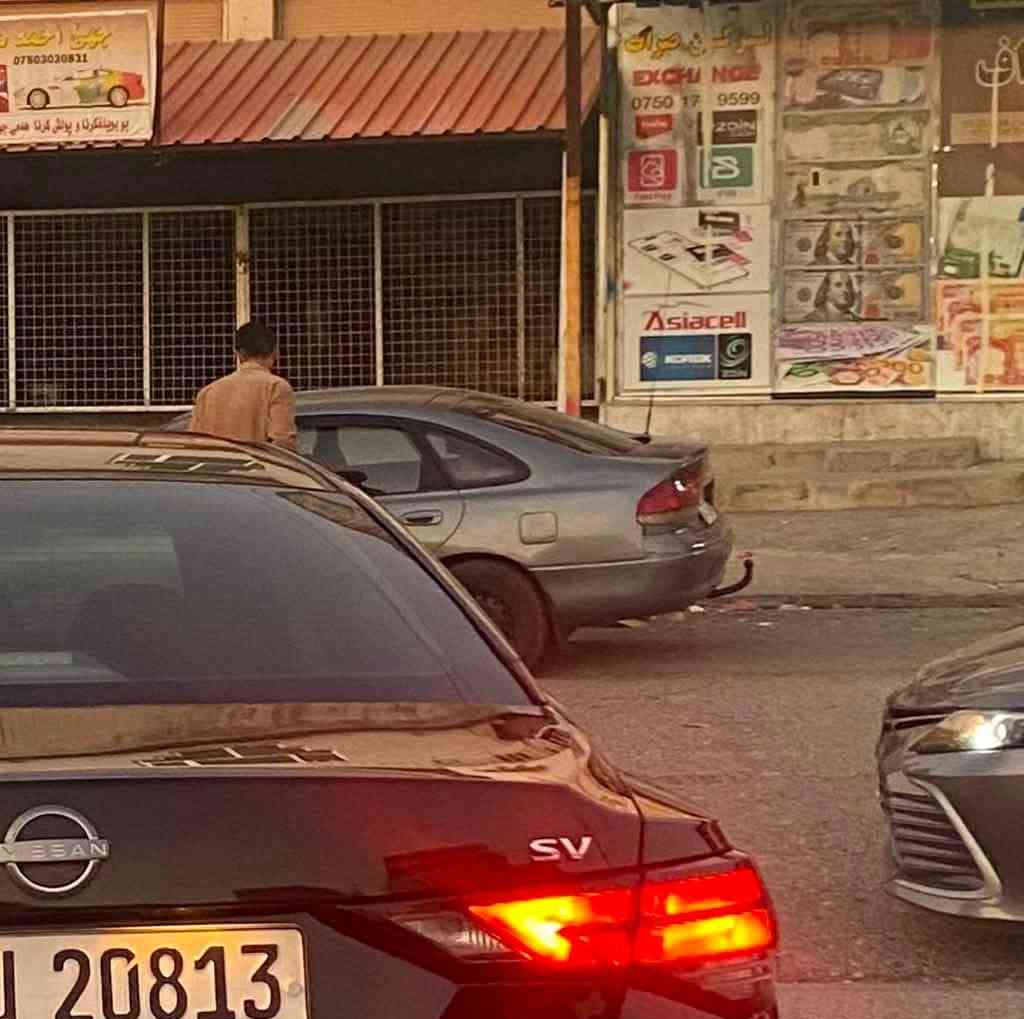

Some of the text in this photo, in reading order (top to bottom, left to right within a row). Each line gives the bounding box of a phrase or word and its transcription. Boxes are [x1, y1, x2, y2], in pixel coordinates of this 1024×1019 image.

[632, 66, 762, 86] EXCHNGE
[717, 92, 760, 105] 9599
[643, 310, 747, 331] Asiacell
[528, 836, 593, 862] SV
